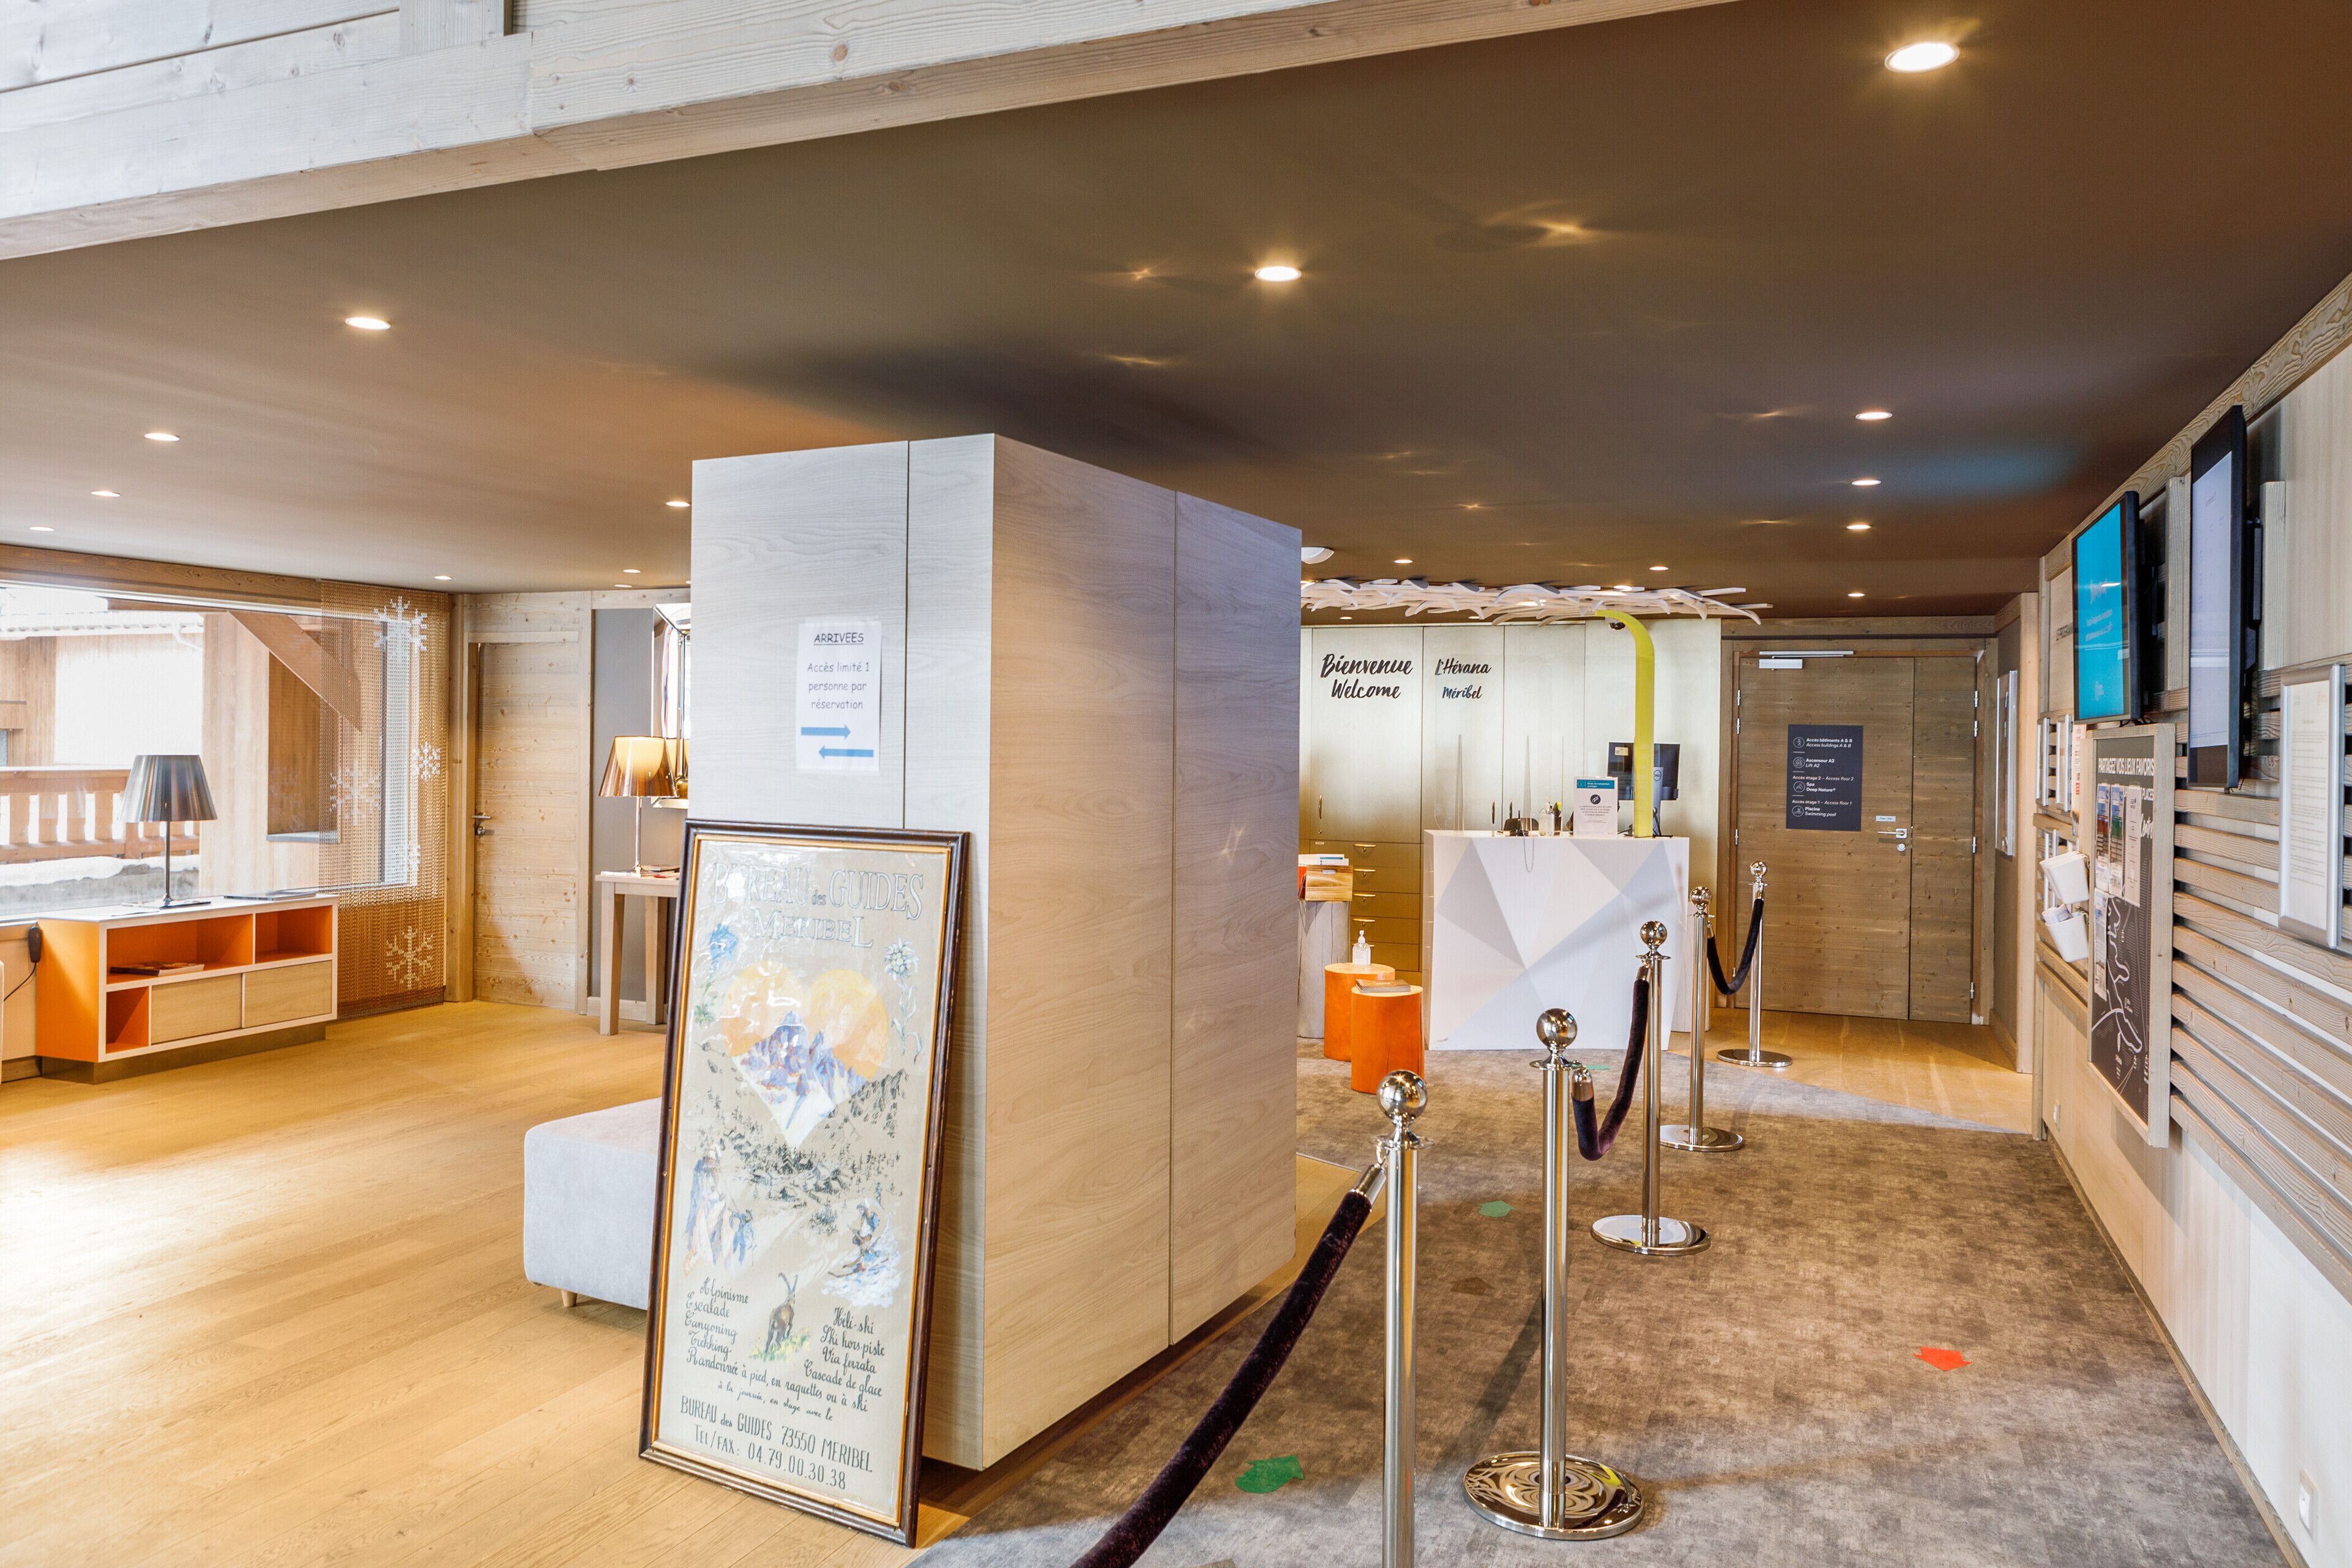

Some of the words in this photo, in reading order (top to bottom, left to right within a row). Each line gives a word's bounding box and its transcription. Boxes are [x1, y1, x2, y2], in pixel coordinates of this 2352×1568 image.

[814, 632, 864, 644] ARRIVEES
[807, 662, 834, 672] Accès
[837, 662, 862, 672] limité
[865, 662, 870, 672] 1
[1321, 653, 1414, 678] Bienvenue
[1435, 657, 1492, 676] L'Hévana
[809, 683, 848, 693] personne
[851, 683, 867, 693] par
[1331, 678, 1401, 699] Welcome
[1442, 685, 1483, 699] Méribel
[812, 699, 863, 709] réservation
[2098, 758, 2116, 774] PARTAGEZ
[712, 862, 811, 905] BREAU
[812, 891, 826, 906] des
[829, 869, 924, 920] GUIDES
[751, 908, 873, 948] MERIBEL
[699, 1276, 749, 1304] Alpinisme
[686, 1291, 730, 1318] Escalade
[685, 1310, 738, 1345] Canyoning
[833, 1306, 874, 1334] Héli-ski
[820, 1325, 839, 1346] Ski
[823, 1346, 840, 1365] Via
[843, 1353, 877, 1376] ferrata
[687, 1346, 738, 1376] Randonnée
[742, 1364, 747, 1378] à
[750, 1370, 769, 1387] pied,
[771, 1378, 781, 1387] en
[785, 1382, 823, 1400] raquettes
[826, 1393, 837, 1403] ou
[841, 1393, 847, 1406] à
[851, 1394, 868, 1412] ski
[804, 1359, 842, 1385] Cascade
[846, 1374, 857, 1390] de
[859, 1374, 883, 1398] glace
[726, 1382, 733, 1392] la
[783, 1398, 801, 1414] stage
[825, 1408, 833, 1421] le
[680, 1395, 717, 1423] BUREAU
[721, 1413, 733, 1427] des
[737, 1412, 772, 1441] GUIDES
[782, 1425, 816, 1453] 73550
[821, 1438, 873, 1472] MERIBEL
[748, 1442, 846, 1490] 04.79.00.30.38
